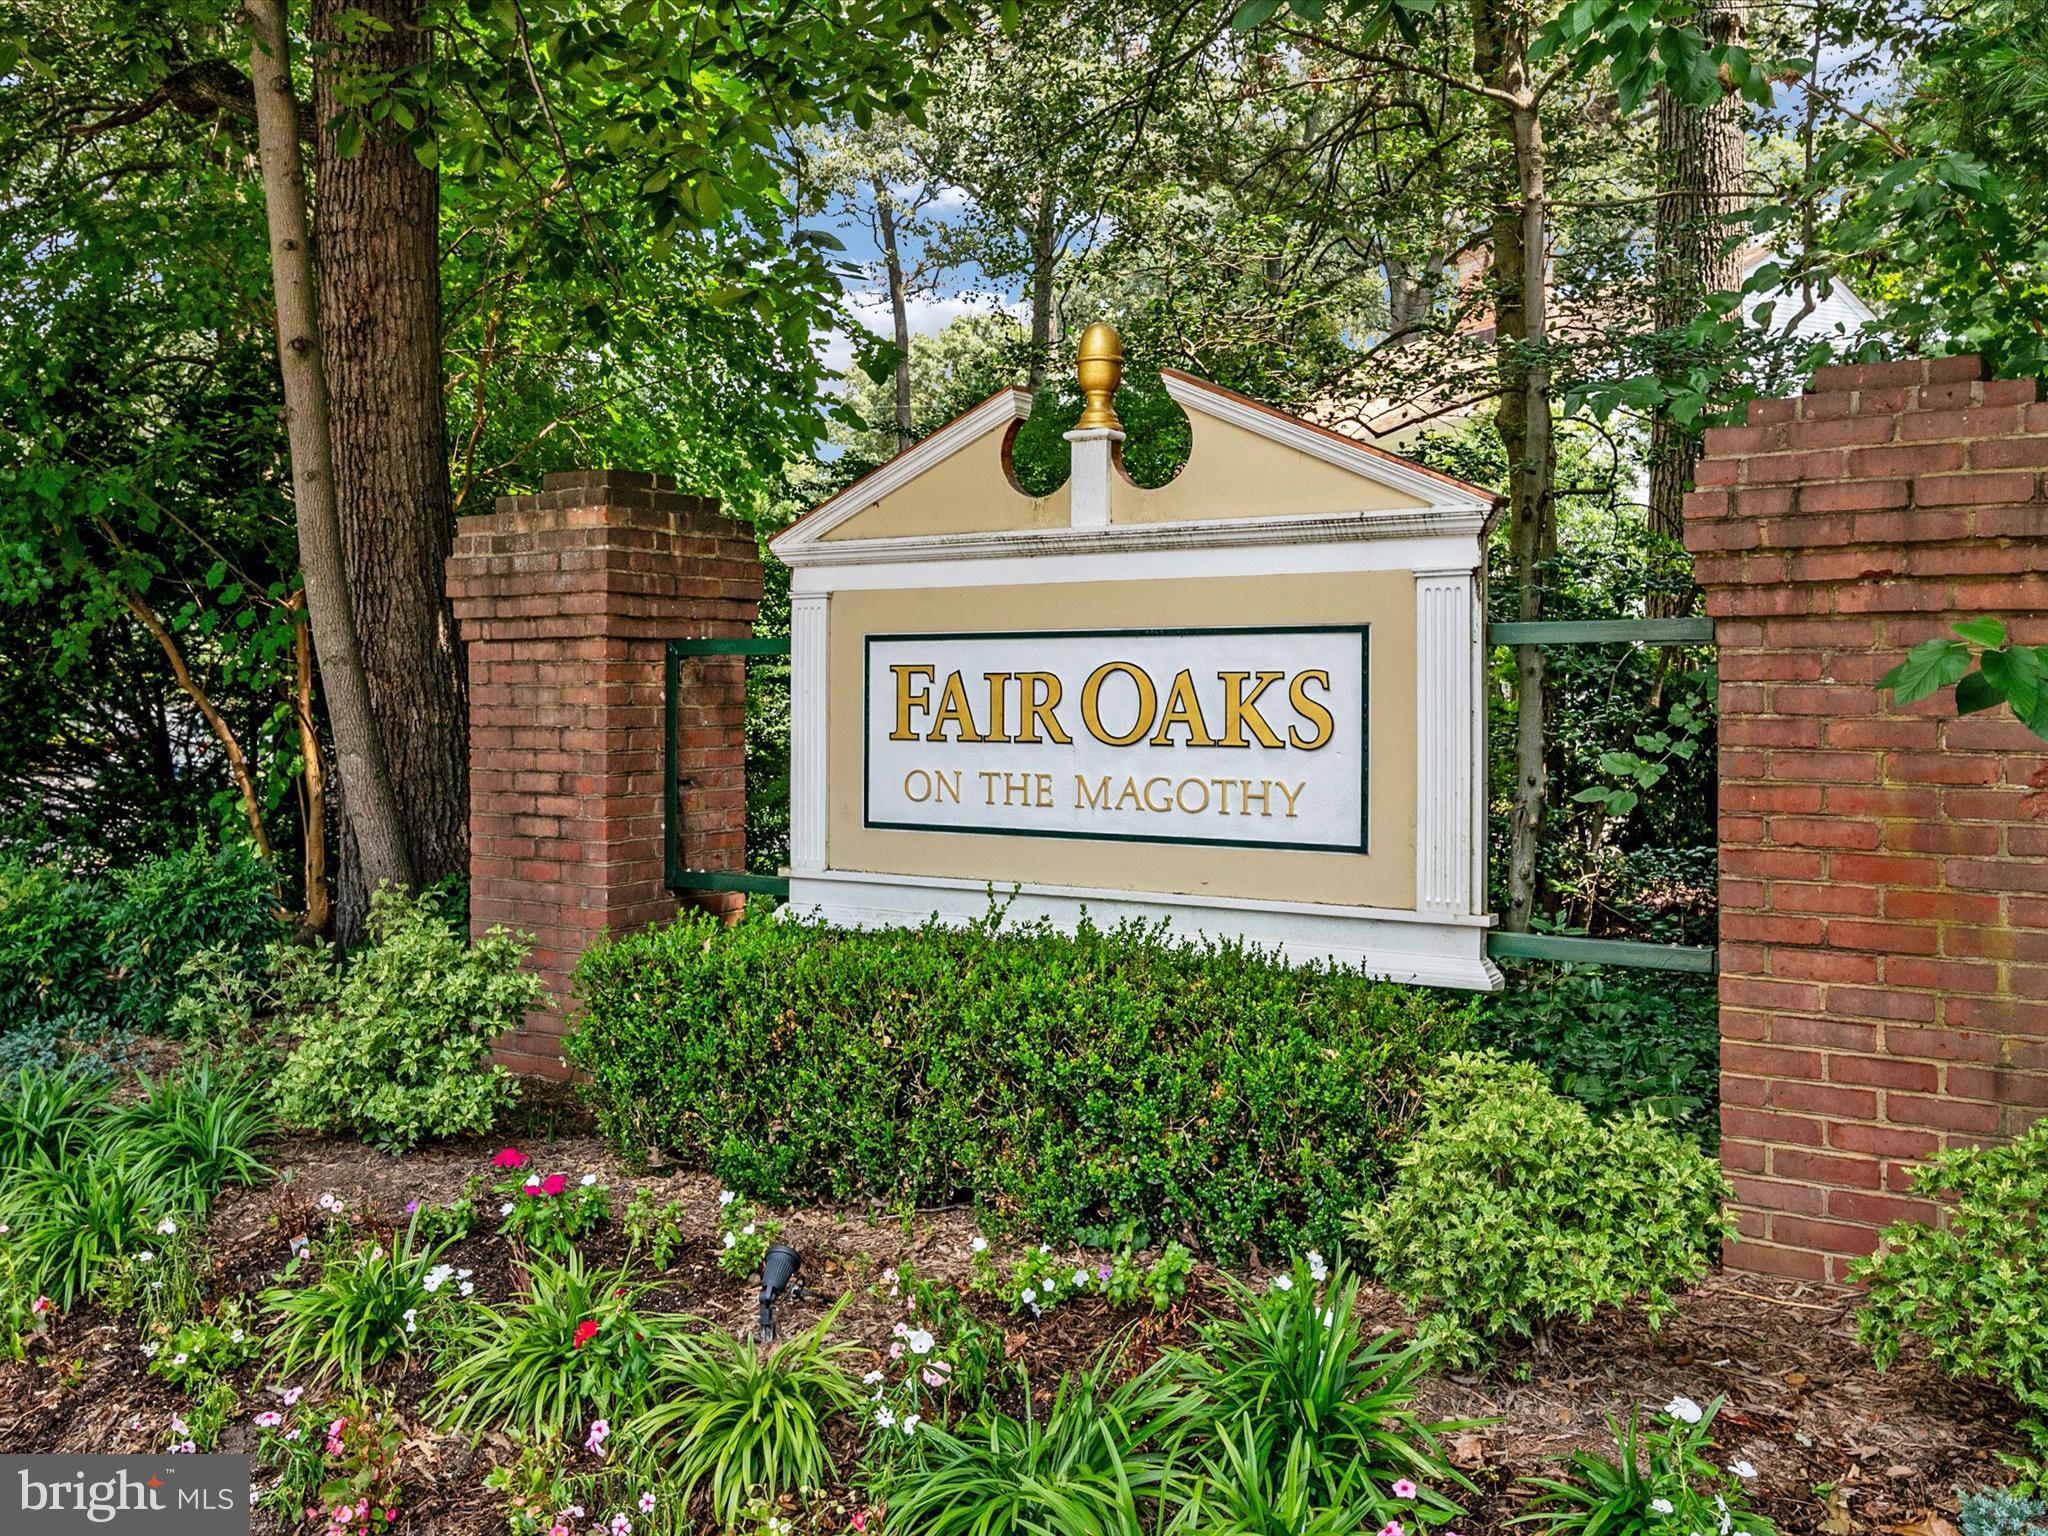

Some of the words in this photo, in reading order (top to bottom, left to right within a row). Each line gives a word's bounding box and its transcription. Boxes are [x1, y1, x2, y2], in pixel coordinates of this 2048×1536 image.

[889, 664, 1073, 745] FAIR
[1081, 661, 1335, 751] OAKS
[904, 769, 961, 803] ON
[979, 771, 1054, 807] THE
[1074, 774, 1307, 817] MAGOTHY
